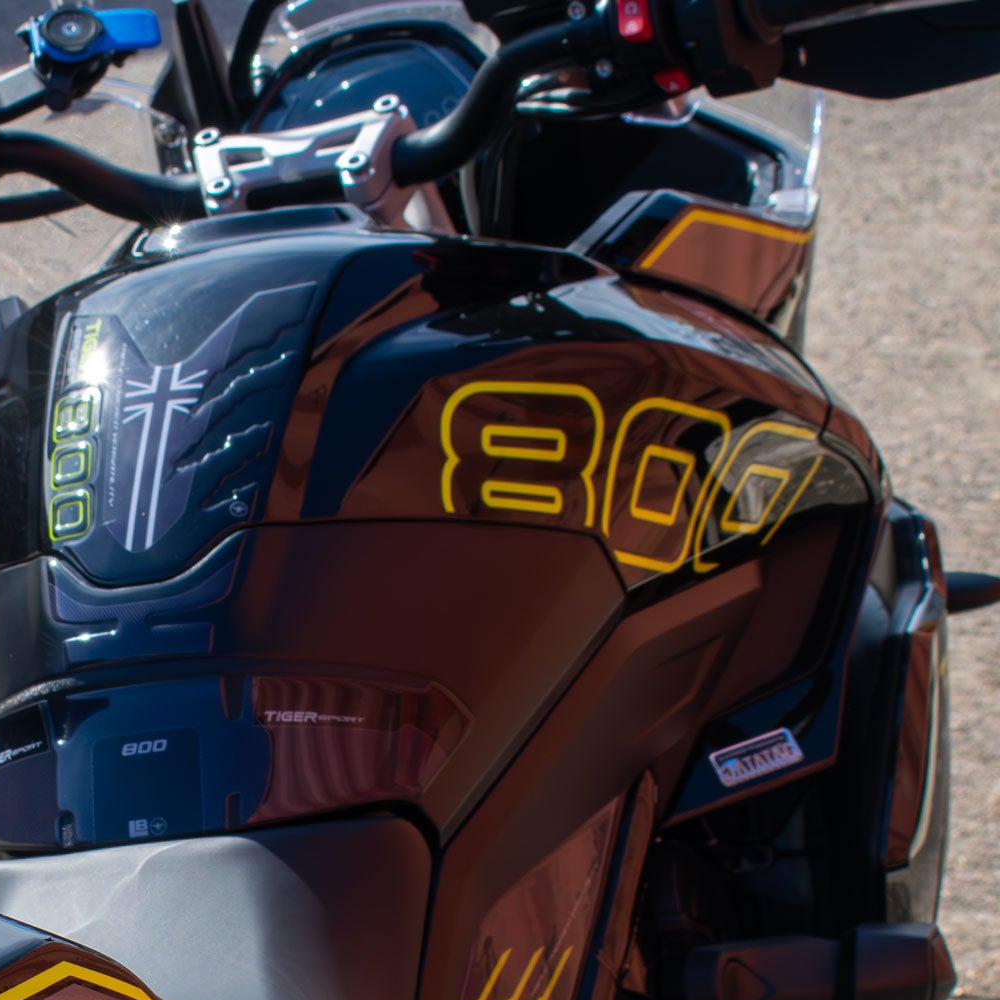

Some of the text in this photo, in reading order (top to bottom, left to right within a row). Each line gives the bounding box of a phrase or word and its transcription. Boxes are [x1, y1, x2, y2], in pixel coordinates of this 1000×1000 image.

[50, 390, 95, 541] 800
[441, 381, 822, 573] 800
[121, 739, 168, 757] 800
[263, 710, 318, 723] TIGER
